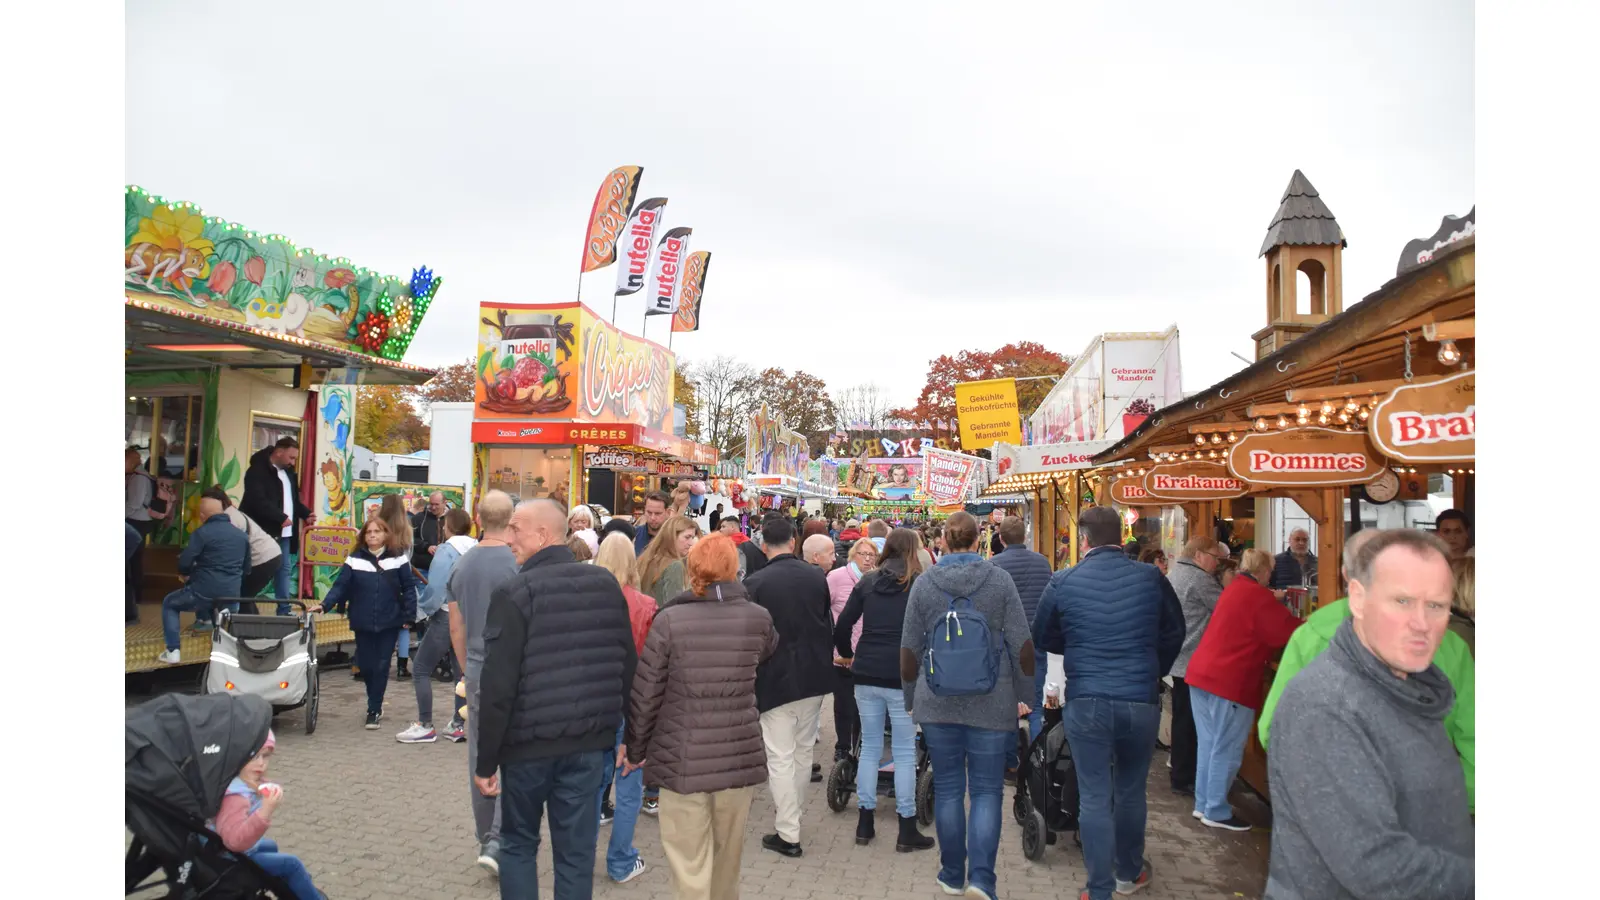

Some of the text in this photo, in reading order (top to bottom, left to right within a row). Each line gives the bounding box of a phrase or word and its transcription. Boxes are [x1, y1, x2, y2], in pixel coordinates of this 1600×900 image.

[627, 209, 656, 287] nutella
[656, 237, 682, 309] nutella
[507, 339, 551, 354] nutella
[1111, 367, 1157, 375] Gebrannte
[969, 393, 1005, 403] Gekühlte
[959, 402, 1017, 414] Schokofrüchte
[970, 420, 1011, 431] Gebrannte
[569, 427, 627, 440] CRÊPES
[975, 430, 1009, 440] Mandeln
[588, 452, 630, 467] Toffifee
[930, 456, 967, 474] Mandeln
[1253, 453, 1366, 471] Pommes
[1156, 475, 1243, 489] Krakauer
